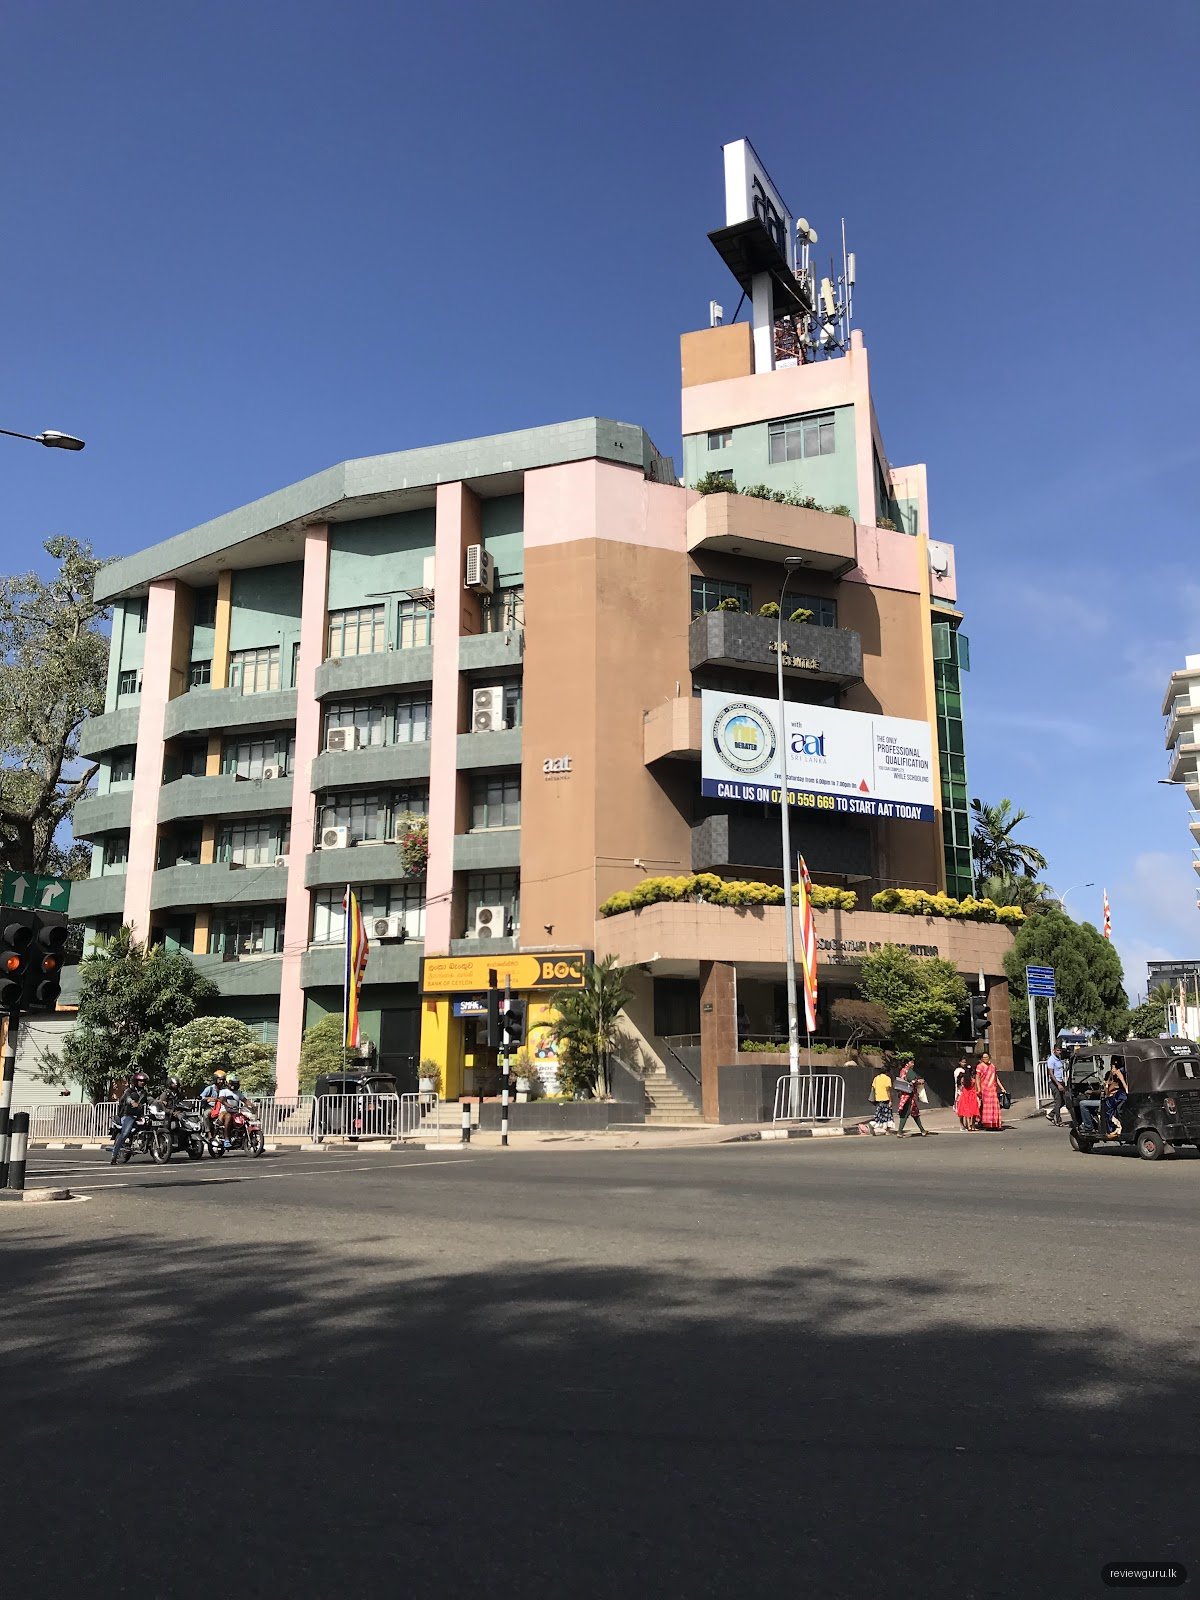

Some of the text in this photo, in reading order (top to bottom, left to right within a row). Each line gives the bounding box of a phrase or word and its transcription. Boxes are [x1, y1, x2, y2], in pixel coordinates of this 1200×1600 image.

[734, 741, 757, 751] DEBATER
[790, 730, 826, 757] aat
[876, 735, 897, 745] THE ONLY
[877, 743, 920, 758] PROFESSIONAL
[543, 755, 573, 773] aat
[804, 756, 827, 764] LANKA
[885, 755, 929, 769] QUALIFICATION
[893, 772, 906, 780] WHILE
[717, 783, 741, 798] CALL
[743, 786, 755, 799] US
[757, 788, 770, 801] ON
[797, 792, 815, 807] 559
[817, 795, 835, 810] 669
[836, 797, 848, 812] TO
[849, 799, 876, 815] START
[877, 804, 894, 817] AAT
[895, 806, 922, 820] TODAY
